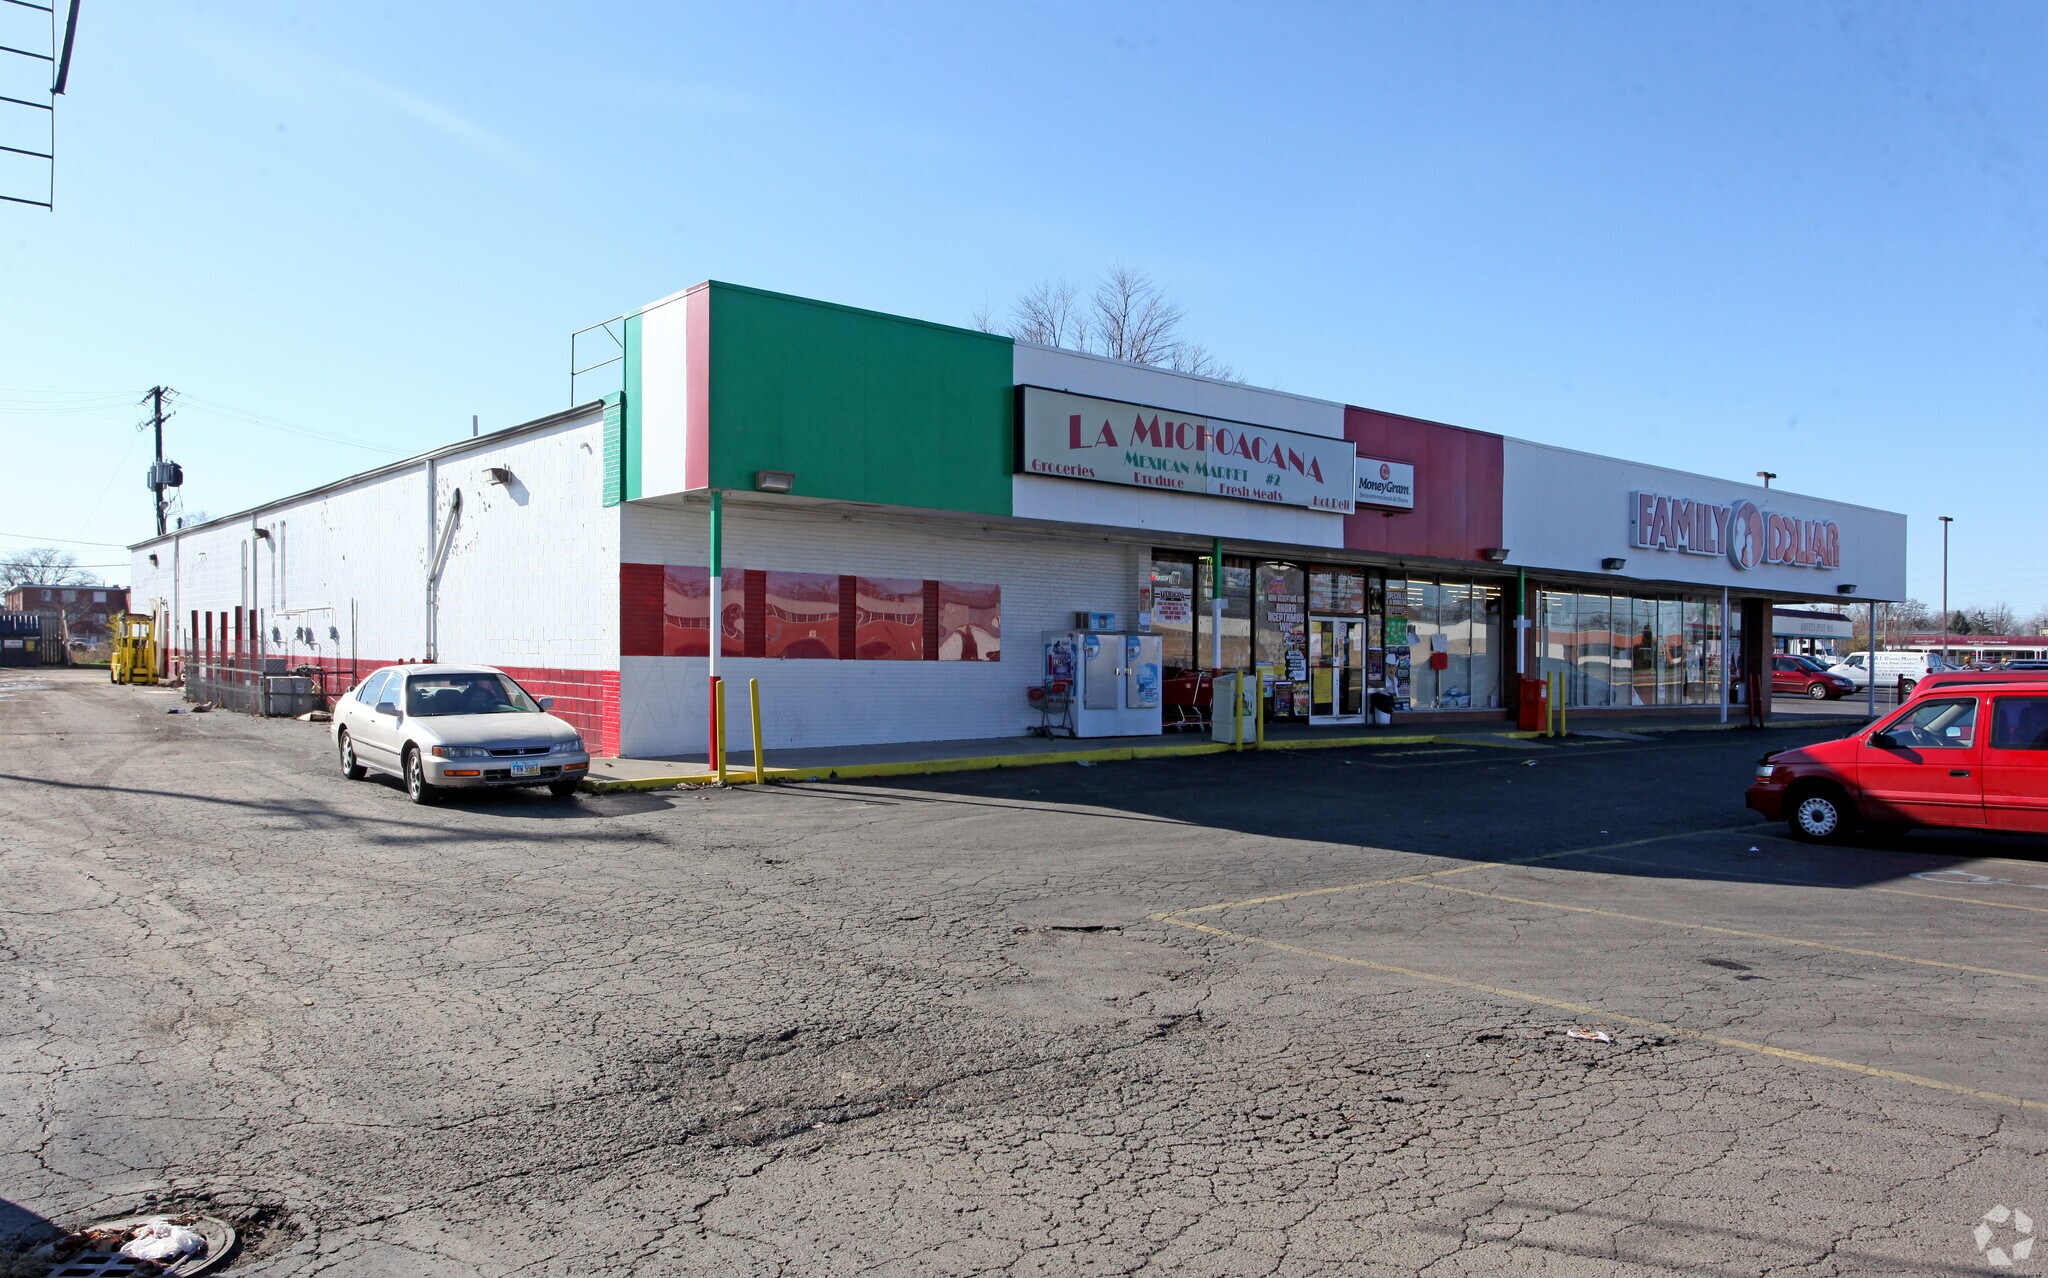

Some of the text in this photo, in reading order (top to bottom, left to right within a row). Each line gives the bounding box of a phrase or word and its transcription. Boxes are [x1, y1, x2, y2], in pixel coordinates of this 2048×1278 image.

[1069, 413, 1324, 484] LA MICHOACANA
[1031, 458, 1095, 478] Groceries
[1124, 450, 1281, 487] MEXICAN MARKET #2
[1133, 472, 1185, 488] Produce
[1359, 477, 1409, 495] MoneyGram
[1219, 483, 1283, 501] Fresh Meats
[1313, 495, 1350, 510] Hot Deli
[1637, 493, 1840, 568] FAMILY DOLLAR
[1276, 603, 1296, 613] AHORA
[1267, 612, 1305, 623] ACEPTAMOS
[1279, 622, 1293, 632] WIC
